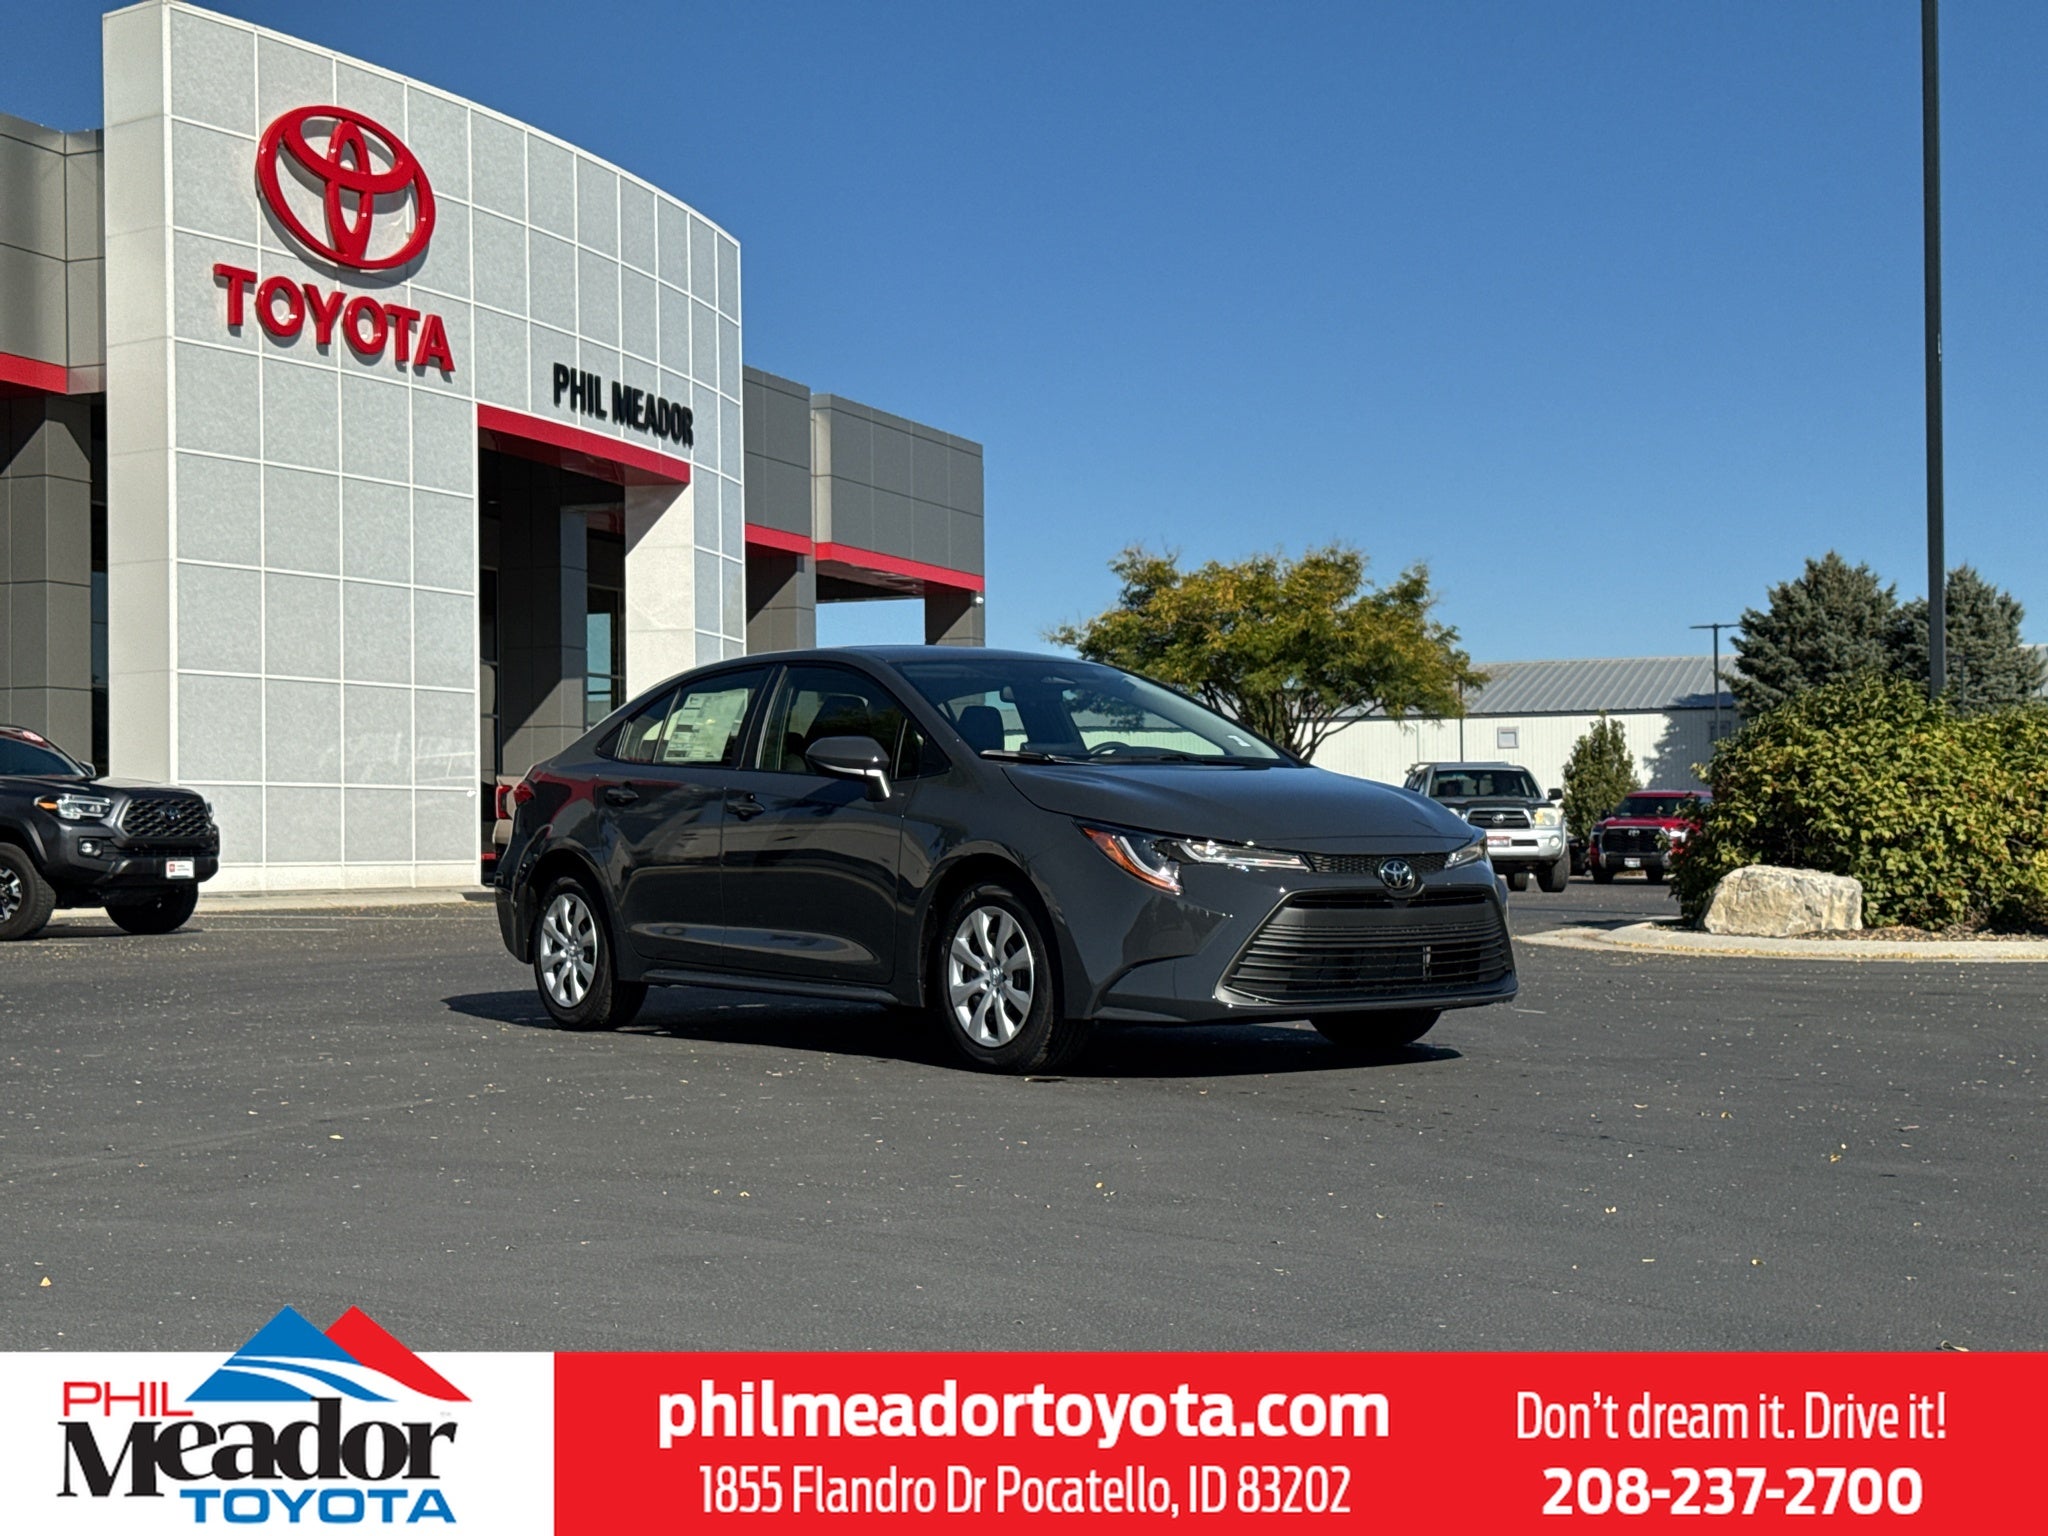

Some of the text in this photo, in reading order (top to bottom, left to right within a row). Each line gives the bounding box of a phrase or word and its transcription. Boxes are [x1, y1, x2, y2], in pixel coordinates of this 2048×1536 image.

[213, 264, 455, 373] TOYOTA
[552, 362, 694, 447] PHIL MEADOR
